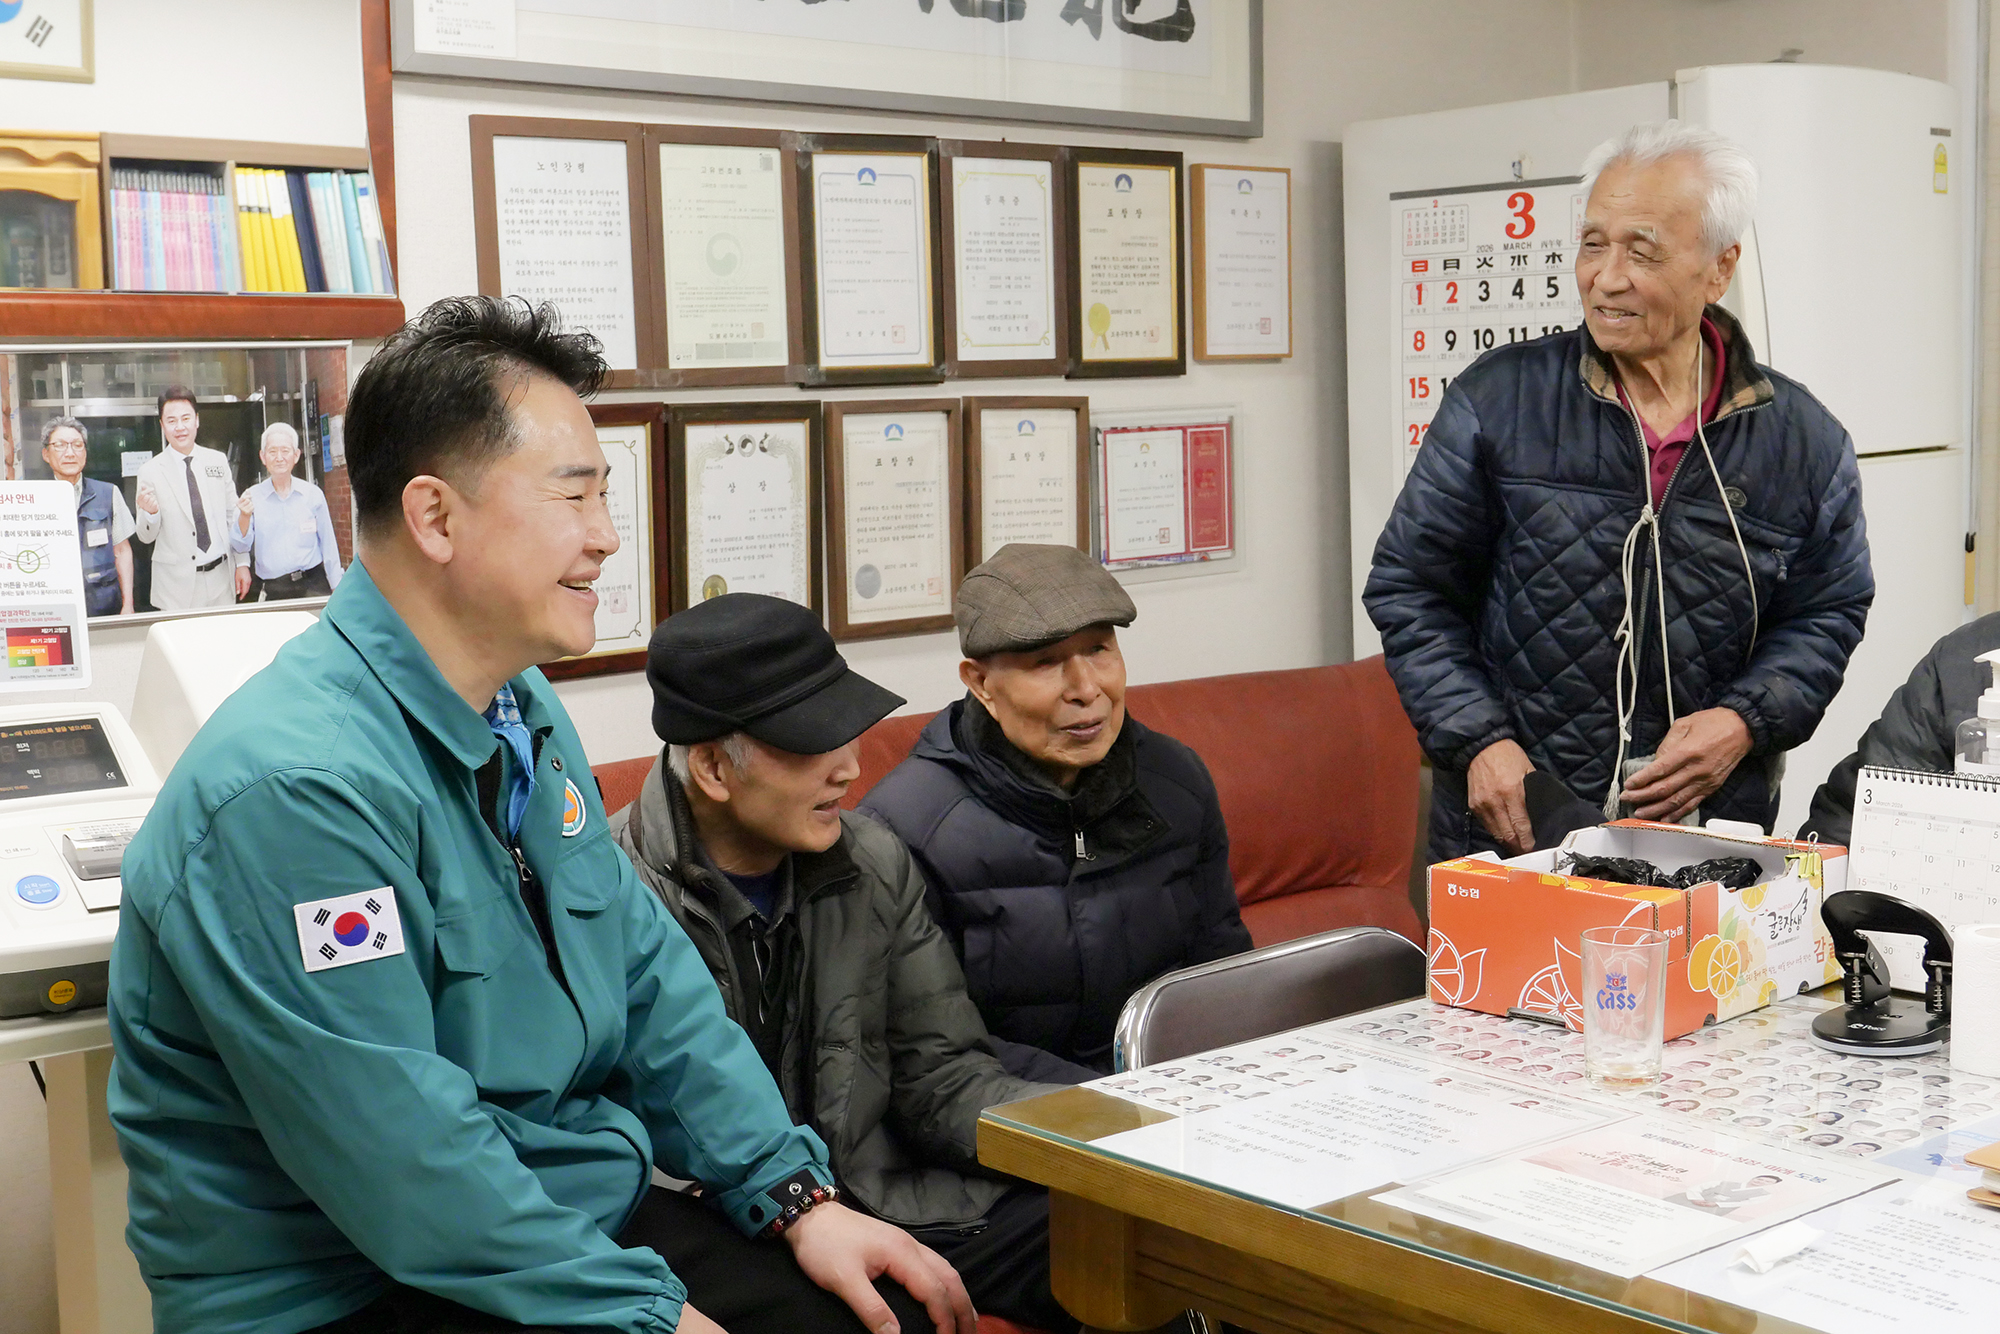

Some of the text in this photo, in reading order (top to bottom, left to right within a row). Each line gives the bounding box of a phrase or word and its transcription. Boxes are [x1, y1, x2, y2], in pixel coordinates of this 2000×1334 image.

[1432, 199, 1439, 208] 2
[1505, 191, 1536, 240] 3
[1476, 244, 1494, 253] 2026
[1503, 241, 1533, 251] MARCH
[1411, 259, 1429, 273] 日
[1476, 256, 1494, 269] 火
[1510, 254, 1528, 267] 水
[1545, 251, 1563, 264] 木
[1415, 276, 1560, 306] 1 2 3 4 5
[1413, 330, 1426, 352] 8
[1444, 329, 1457, 352] 9
[1473, 328, 1495, 350] 10
[1409, 376, 1430, 399] 15
[15, 493, 35, 504] 안내
[2, 513, 20, 521] 최대한
[3, 581, 21, 589] 버튼을
[1863, 788, 1873, 805] 3
[1875, 799, 1904, 809] March 2026
[1864, 814, 1868, 822] 1
[1894, 818, 1900, 826] 2
[1926, 822, 1932, 831] 3
[1993, 831, 1999, 839] 5
[1859, 846, 2000, 873] 8 9 10 11 12
[24, 882, 38, 890] 시작
[1458, 885, 1480, 899] 농협
[1857, 877, 1998, 906] 15 16 17 18 19
[1767, 901, 1806, 940] 귤로장생
[1670, 925, 1684, 939] 농협
[1883, 946, 1894, 955] 30
[1596, 988, 1637, 1011] Cass
